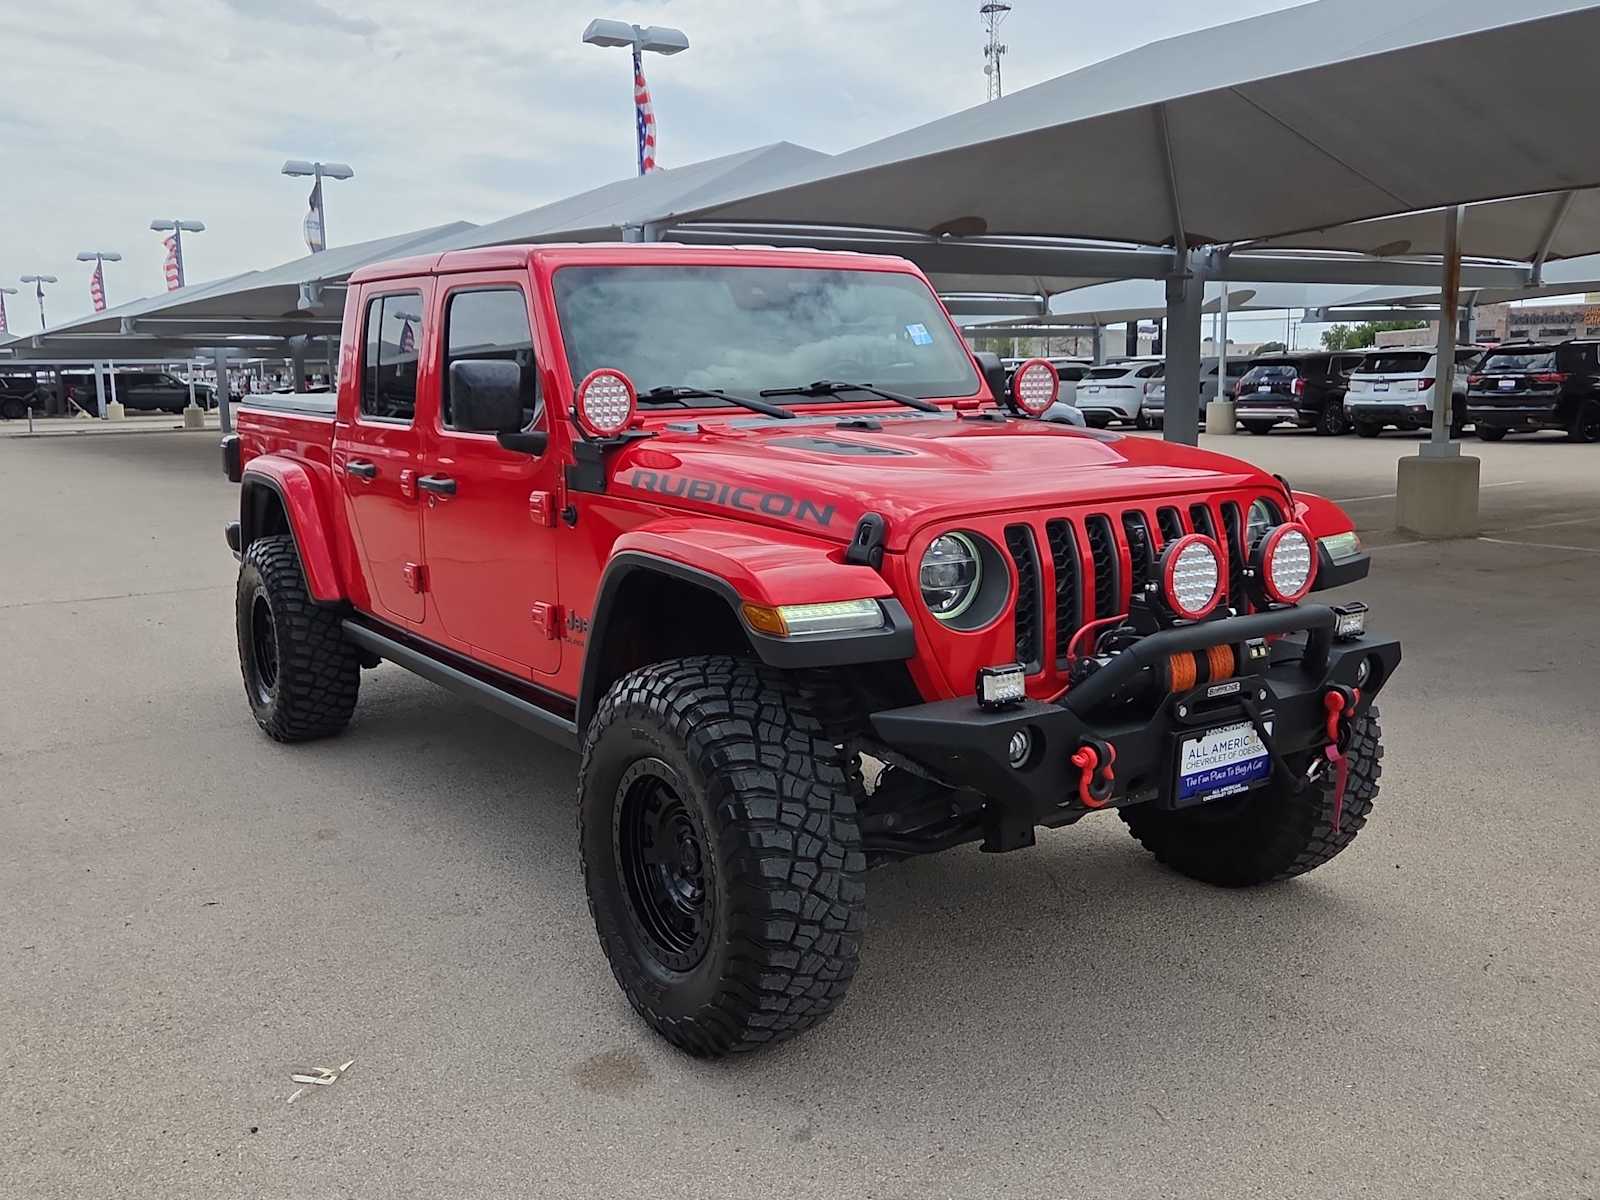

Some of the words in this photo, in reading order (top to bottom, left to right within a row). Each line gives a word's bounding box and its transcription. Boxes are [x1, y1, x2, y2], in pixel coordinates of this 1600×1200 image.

[631, 470, 838, 527] RUBICON
[1186, 753, 1226, 769] CHEVROLET
[1227, 750, 1237, 760] OF
[1189, 746, 1208, 760] ALL
[1212, 735, 1258, 754] AMERIC
